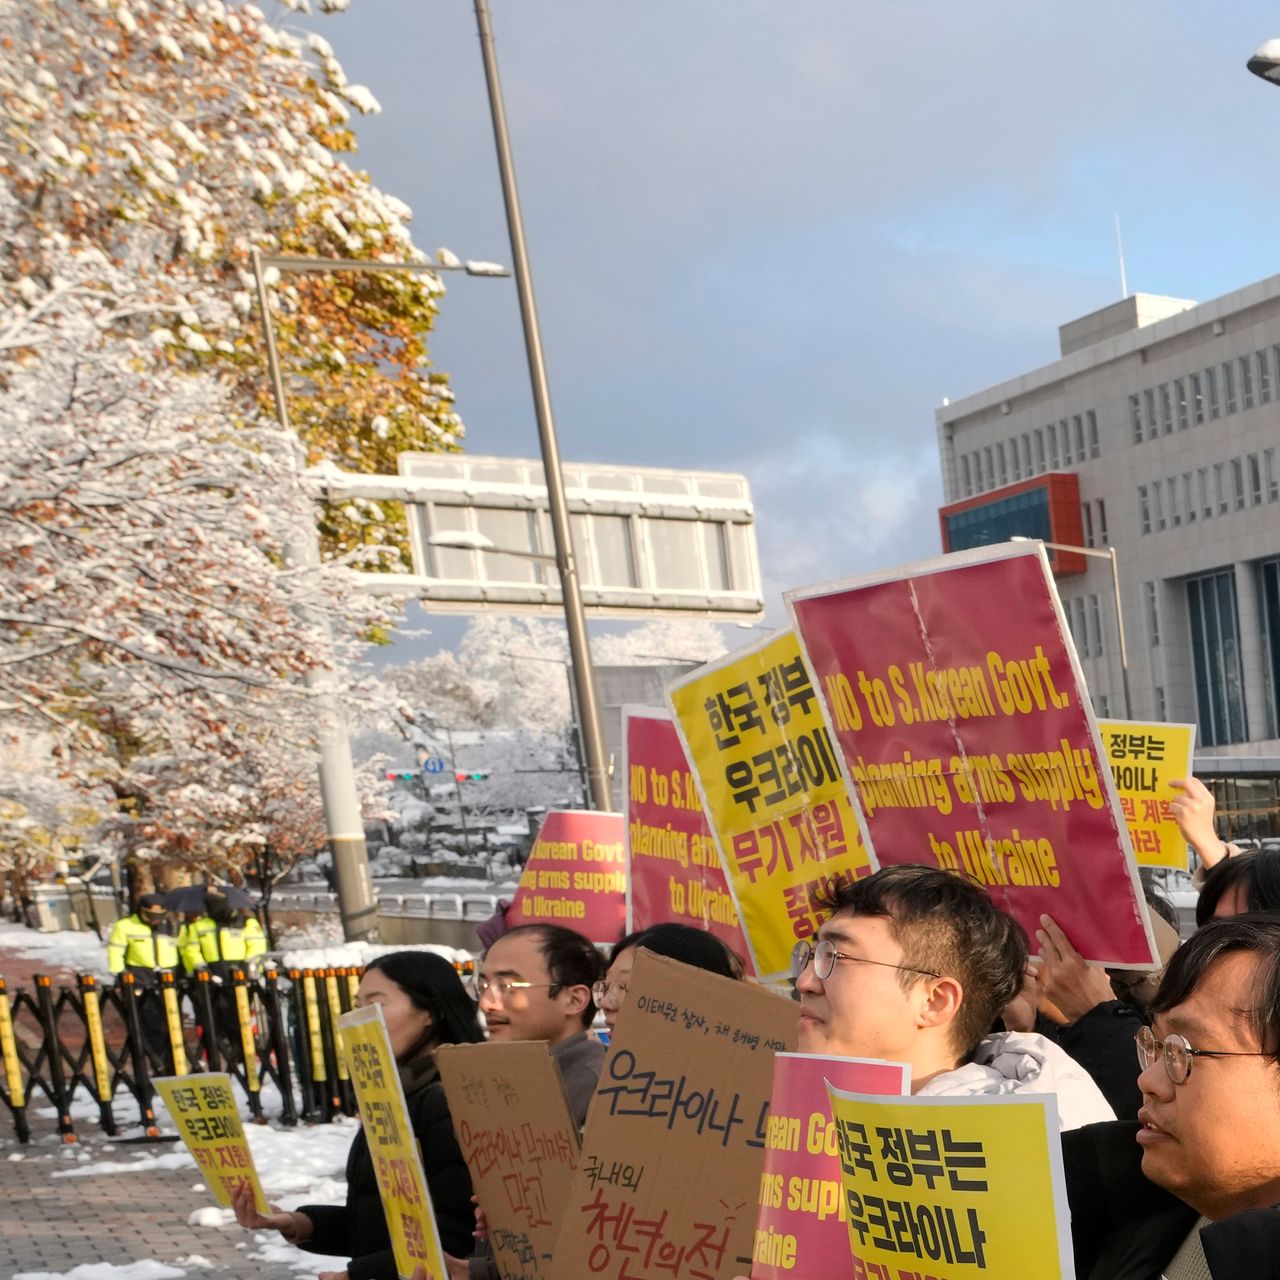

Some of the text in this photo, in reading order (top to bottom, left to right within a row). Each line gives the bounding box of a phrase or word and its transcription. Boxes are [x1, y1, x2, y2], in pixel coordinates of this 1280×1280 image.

[704, 681, 767, 752] 한국
[825, 671, 863, 731] NO
[857, 670, 896, 728] to
[985, 645, 1070, 716] Govt.
[725, 726, 843, 814] 우크라이
[1110, 733, 1165, 761] 정부는
[630, 764, 647, 804] NO
[651, 767, 669, 806] to
[851, 738, 1105, 818] planning arms supply
[629, 818, 688, 868] planning
[732, 820, 795, 884] 무기
[790, 798, 848, 865] 지원
[955, 829, 1060, 888] Ukraine
[533, 895, 586, 919] Ukraine
[538, 870, 570, 890] arms
[669, 876, 685, 915] to
[637, 995, 678, 1024] 이태원
[681, 1008, 710, 1036] 참사,
[732, 1028, 760, 1051] 해병
[171, 1087, 202, 1113] 한국
[598, 1049, 745, 1147] 우크라이나
[583, 1155, 645, 1193] 국내외
[835, 1115, 878, 1182] 한국
[875, 1126, 989, 1192] 정부는
[502, 1170, 553, 1229] 말고
[846, 1189, 987, 1269] 우크라이나
